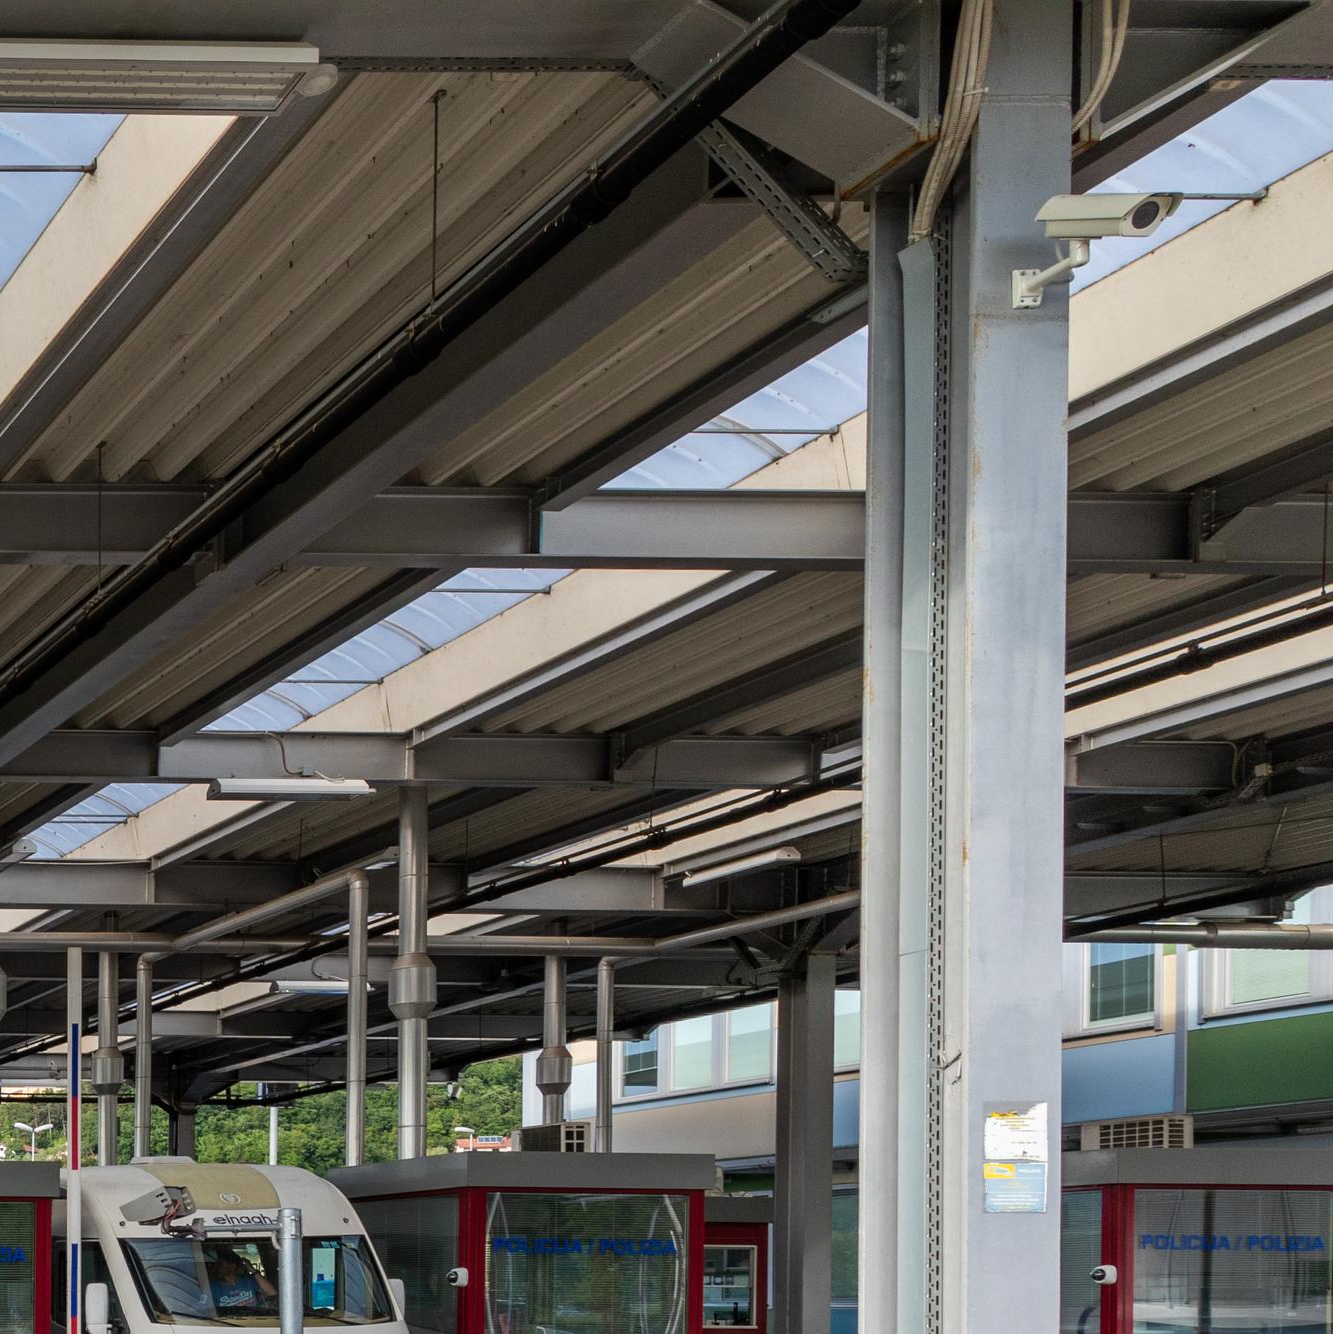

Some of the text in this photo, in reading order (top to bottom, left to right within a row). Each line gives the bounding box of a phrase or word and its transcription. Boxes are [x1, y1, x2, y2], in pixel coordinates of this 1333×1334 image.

[493, 1236, 582, 1254] POLICIJA
[599, 1237, 678, 1256] POLIZIA
[1140, 1235, 1231, 1250] POLICIJA
[1248, 1235, 1325, 1251] POLIZIA
